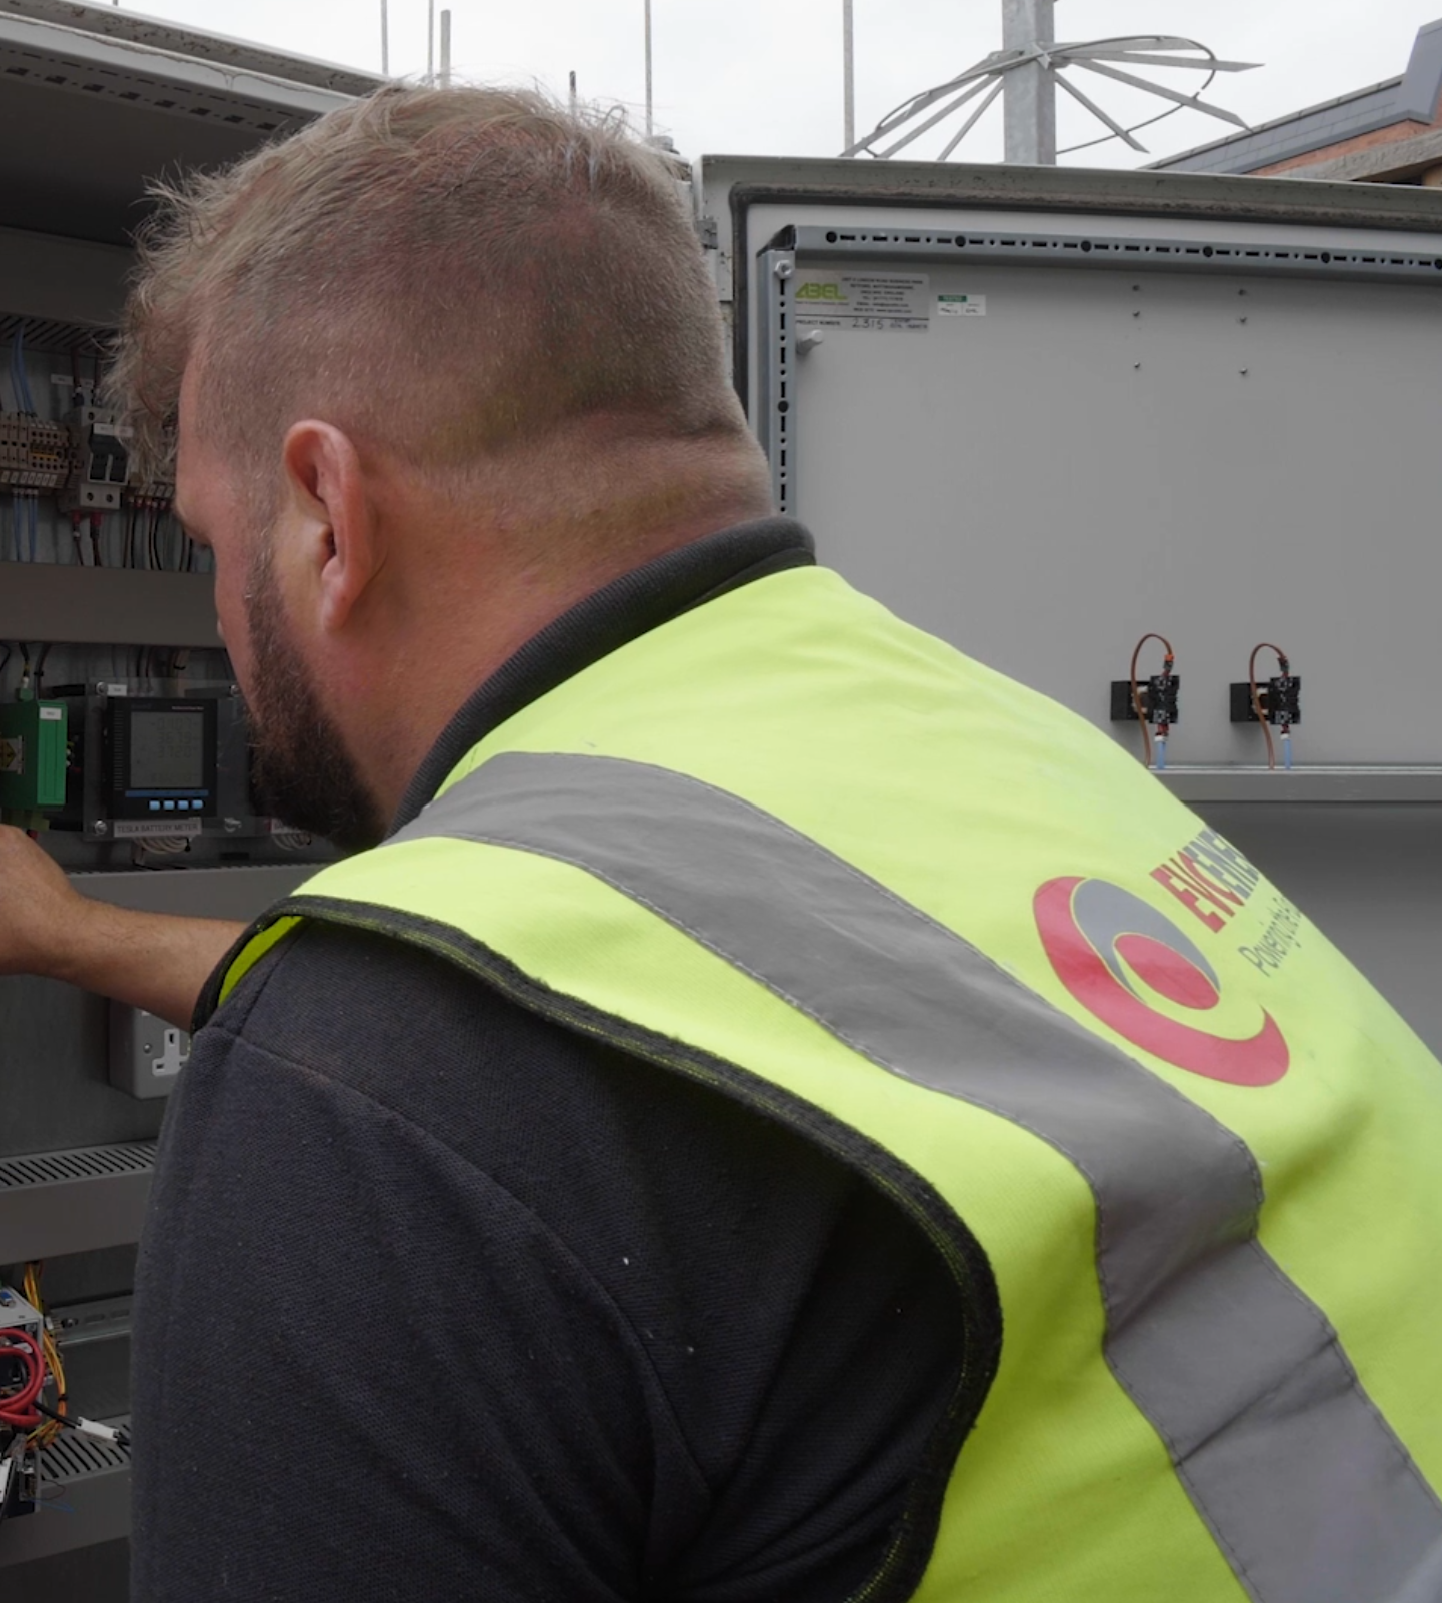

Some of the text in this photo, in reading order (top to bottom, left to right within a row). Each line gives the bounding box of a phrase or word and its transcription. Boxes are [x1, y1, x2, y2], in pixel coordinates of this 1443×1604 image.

[117, 823, 199, 833] TESLA BATTERY METER
